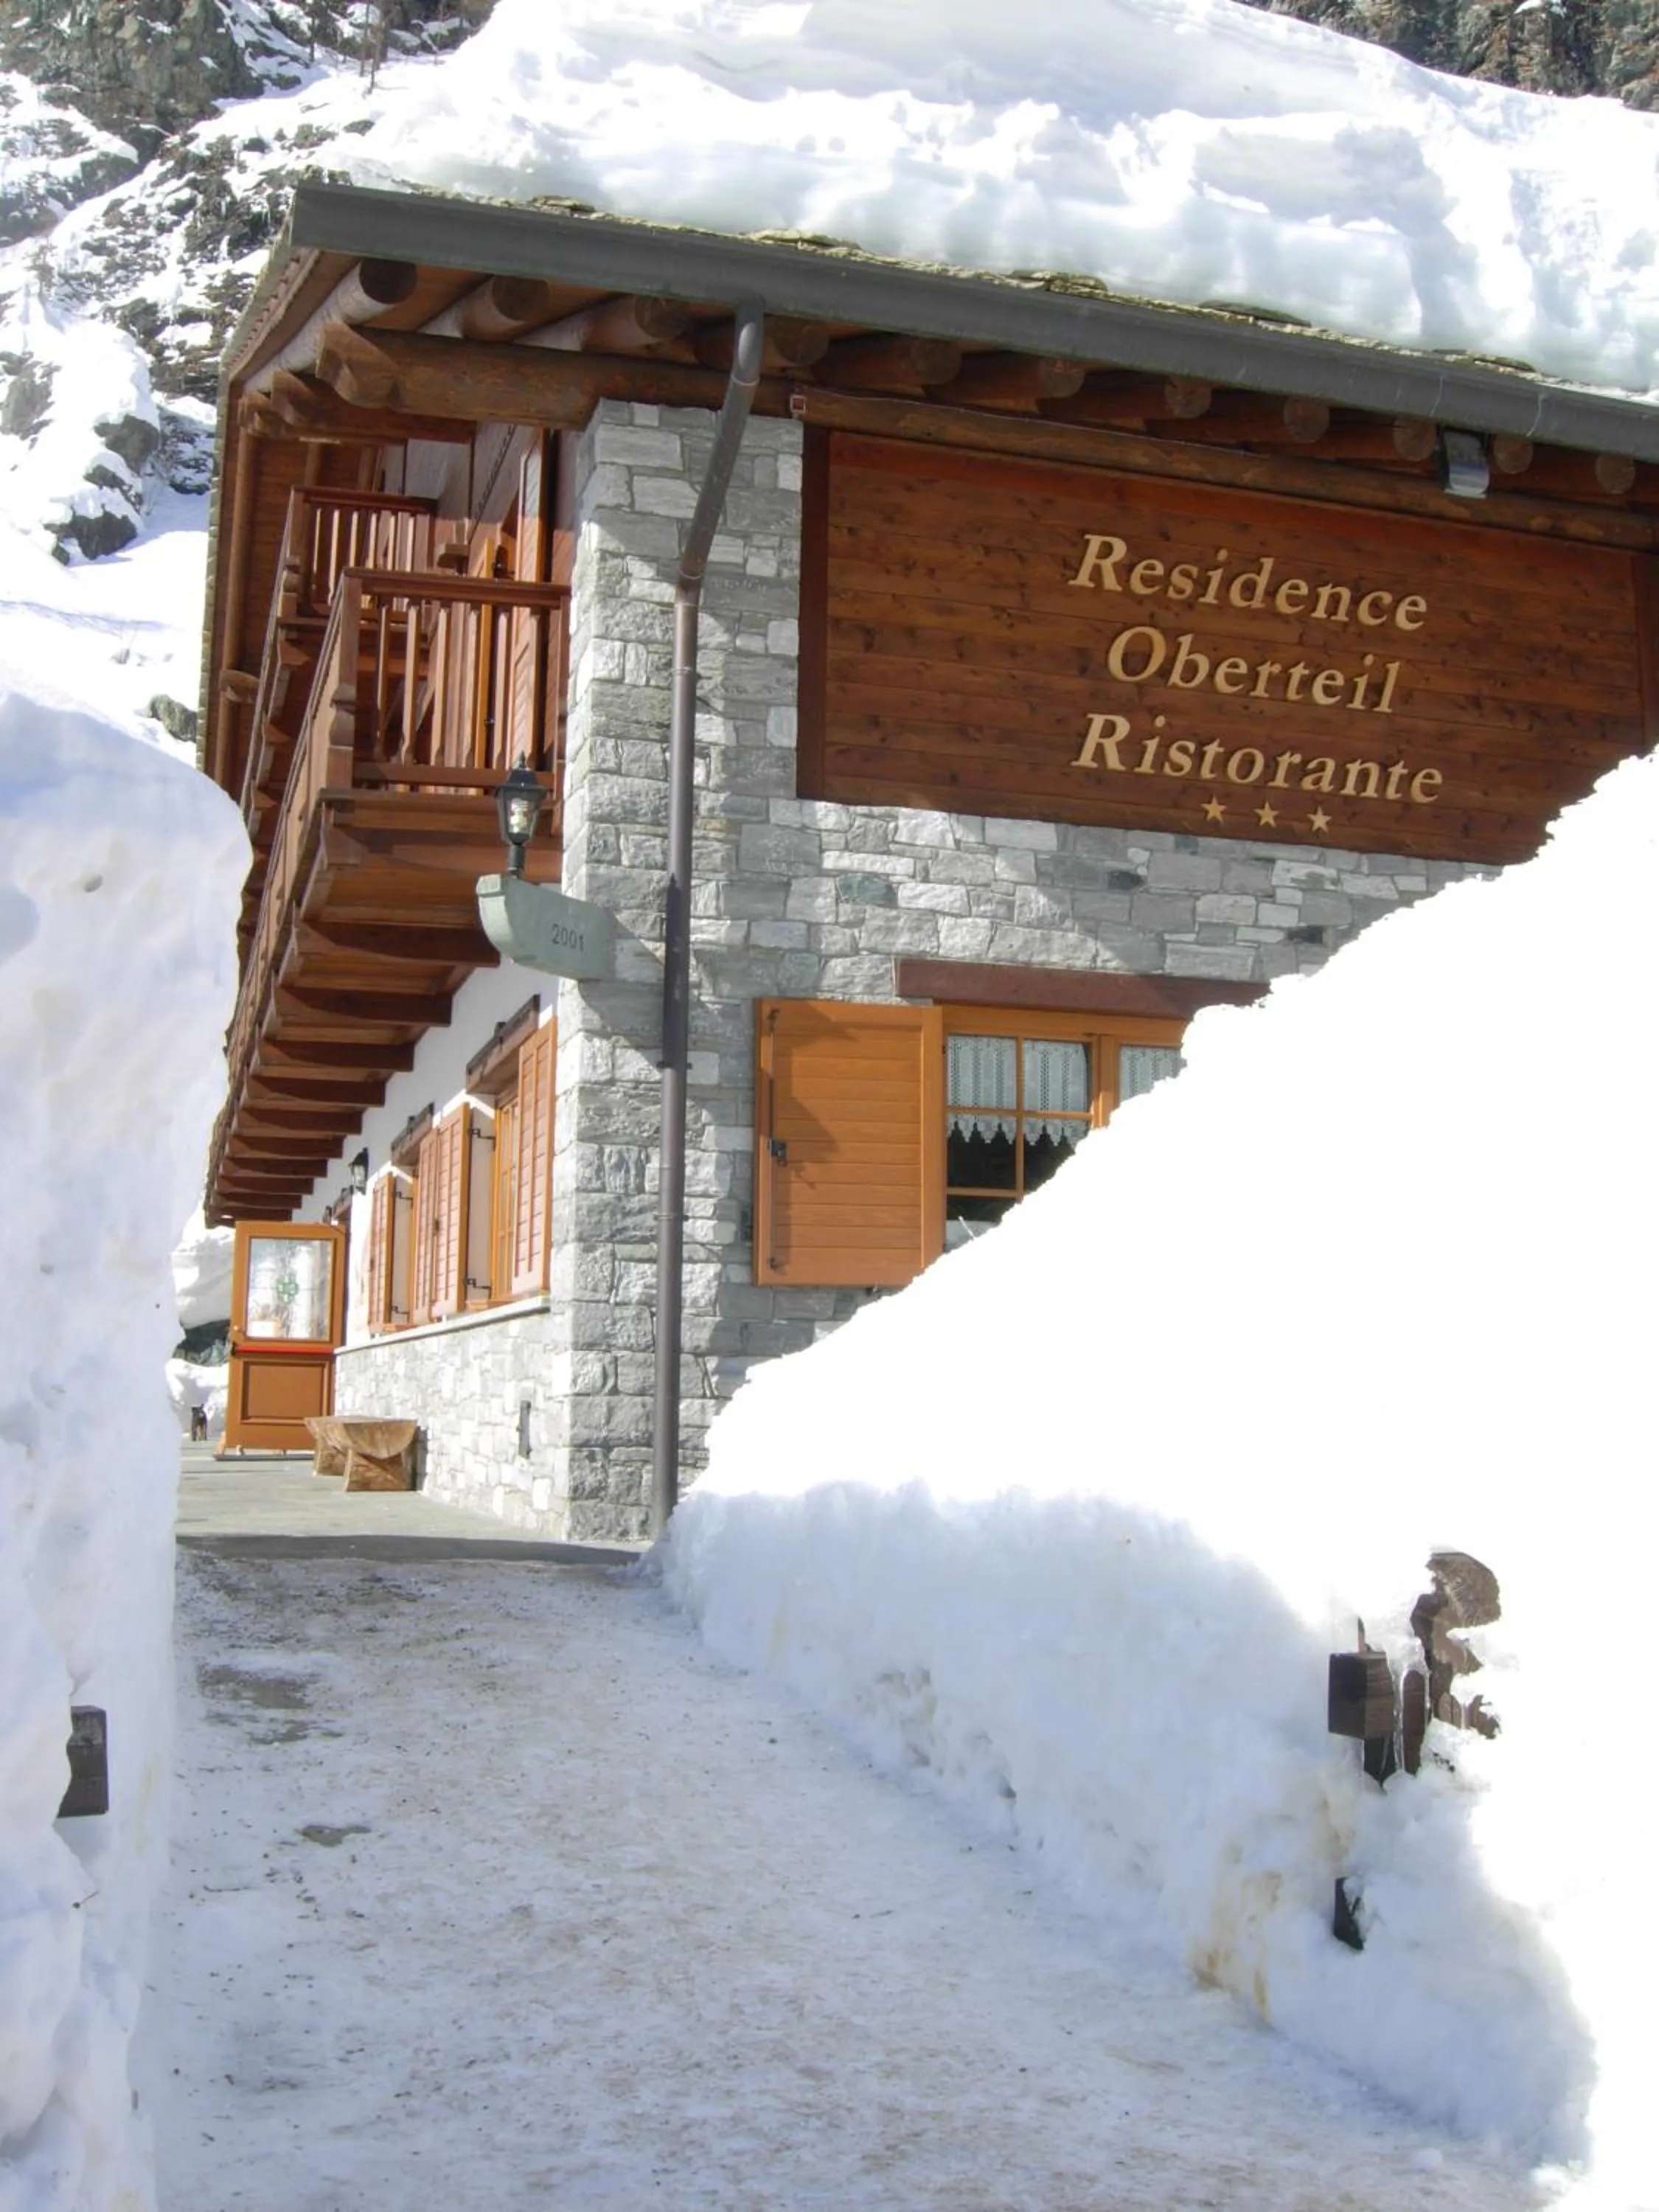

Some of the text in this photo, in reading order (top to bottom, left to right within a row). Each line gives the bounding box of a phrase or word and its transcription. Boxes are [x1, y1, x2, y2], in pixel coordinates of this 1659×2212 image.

[1068, 534, 1427, 630] Residence
[1107, 626, 1400, 714] Oberteil
[1071, 713, 1444, 804] Ristorante
[552, 923, 585, 952] 2001
